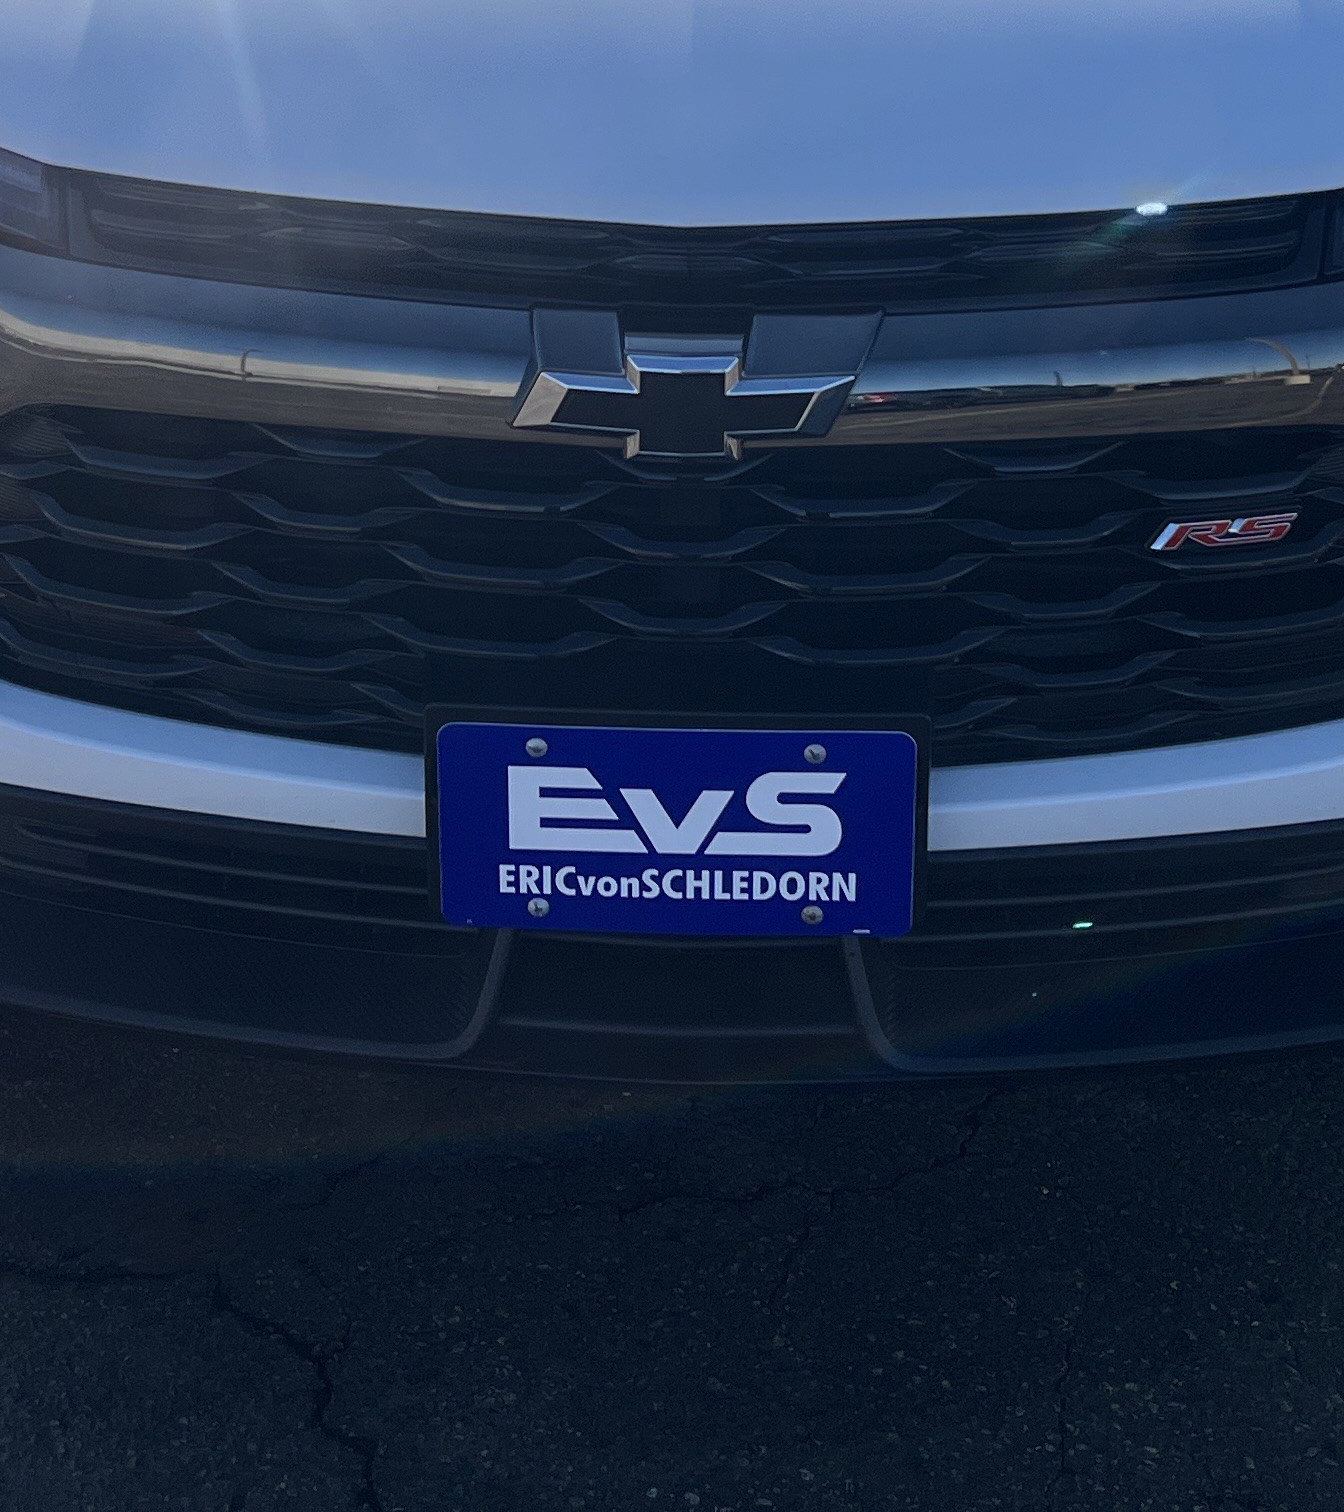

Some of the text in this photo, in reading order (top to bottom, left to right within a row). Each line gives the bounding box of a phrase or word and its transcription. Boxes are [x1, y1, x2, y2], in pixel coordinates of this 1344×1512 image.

[1150, 512, 1298, 551] RS
[507, 765, 847, 857] EvS
[499, 863, 857, 903] ERICvonSCHLEDORN
